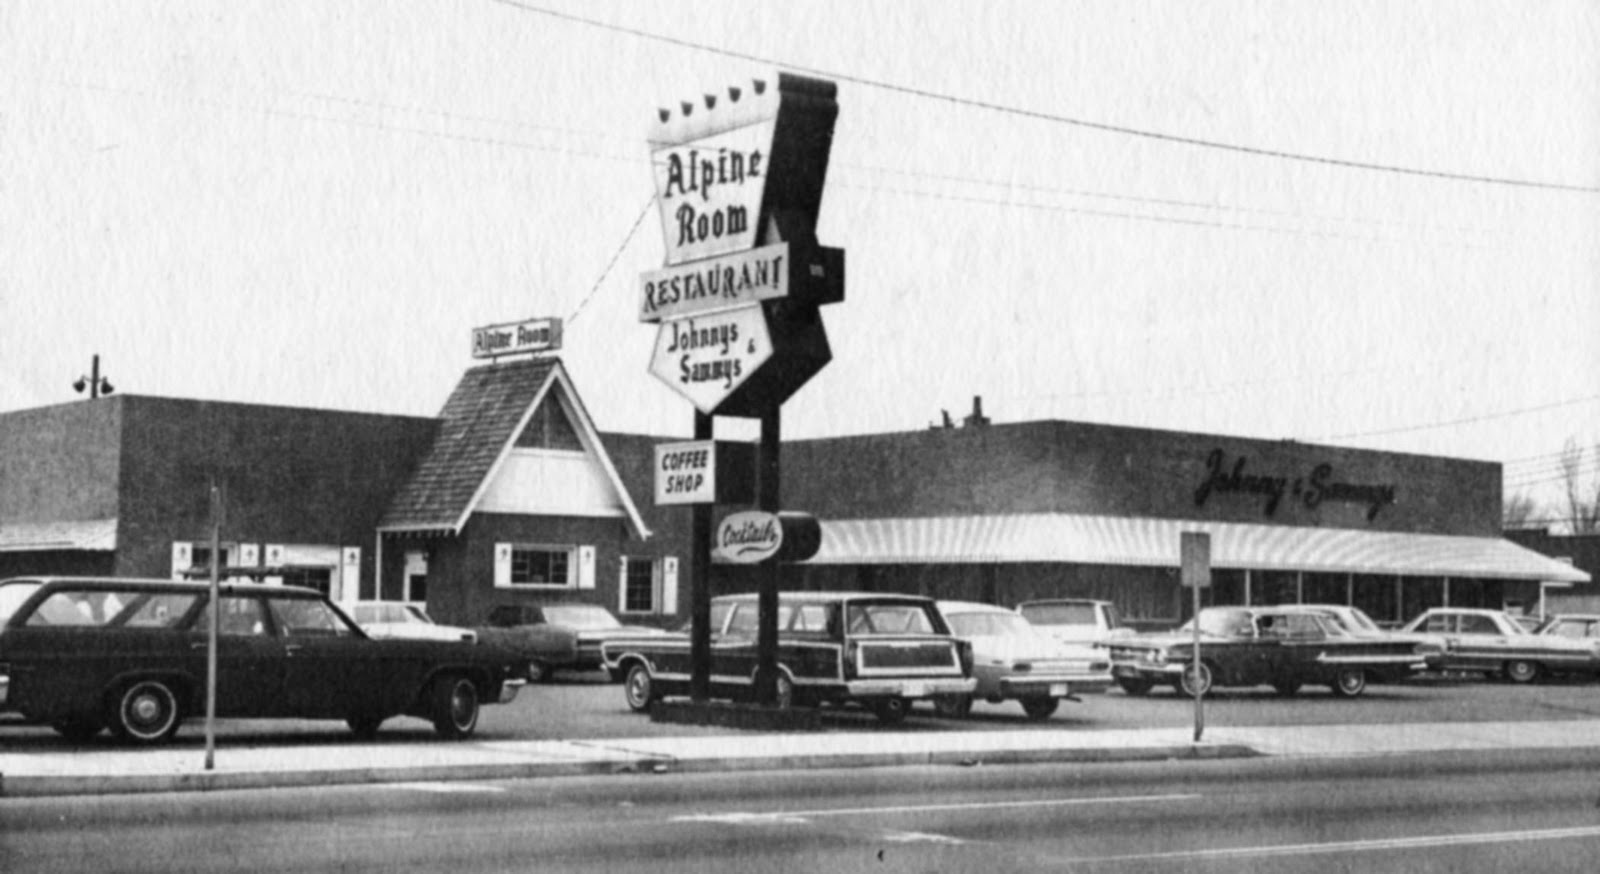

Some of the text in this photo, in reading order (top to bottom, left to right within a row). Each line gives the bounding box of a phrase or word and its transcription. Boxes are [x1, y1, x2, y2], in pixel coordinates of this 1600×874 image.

[664, 147, 762, 202] Alpine
[676, 202, 748, 248] Room
[643, 255, 783, 313] RESTAURANT
[667, 318, 739, 355] Johnnys
[679, 353, 742, 389] Sammys
[661, 449, 708, 471] COFFEE
[665, 474, 704, 494] SHOP
